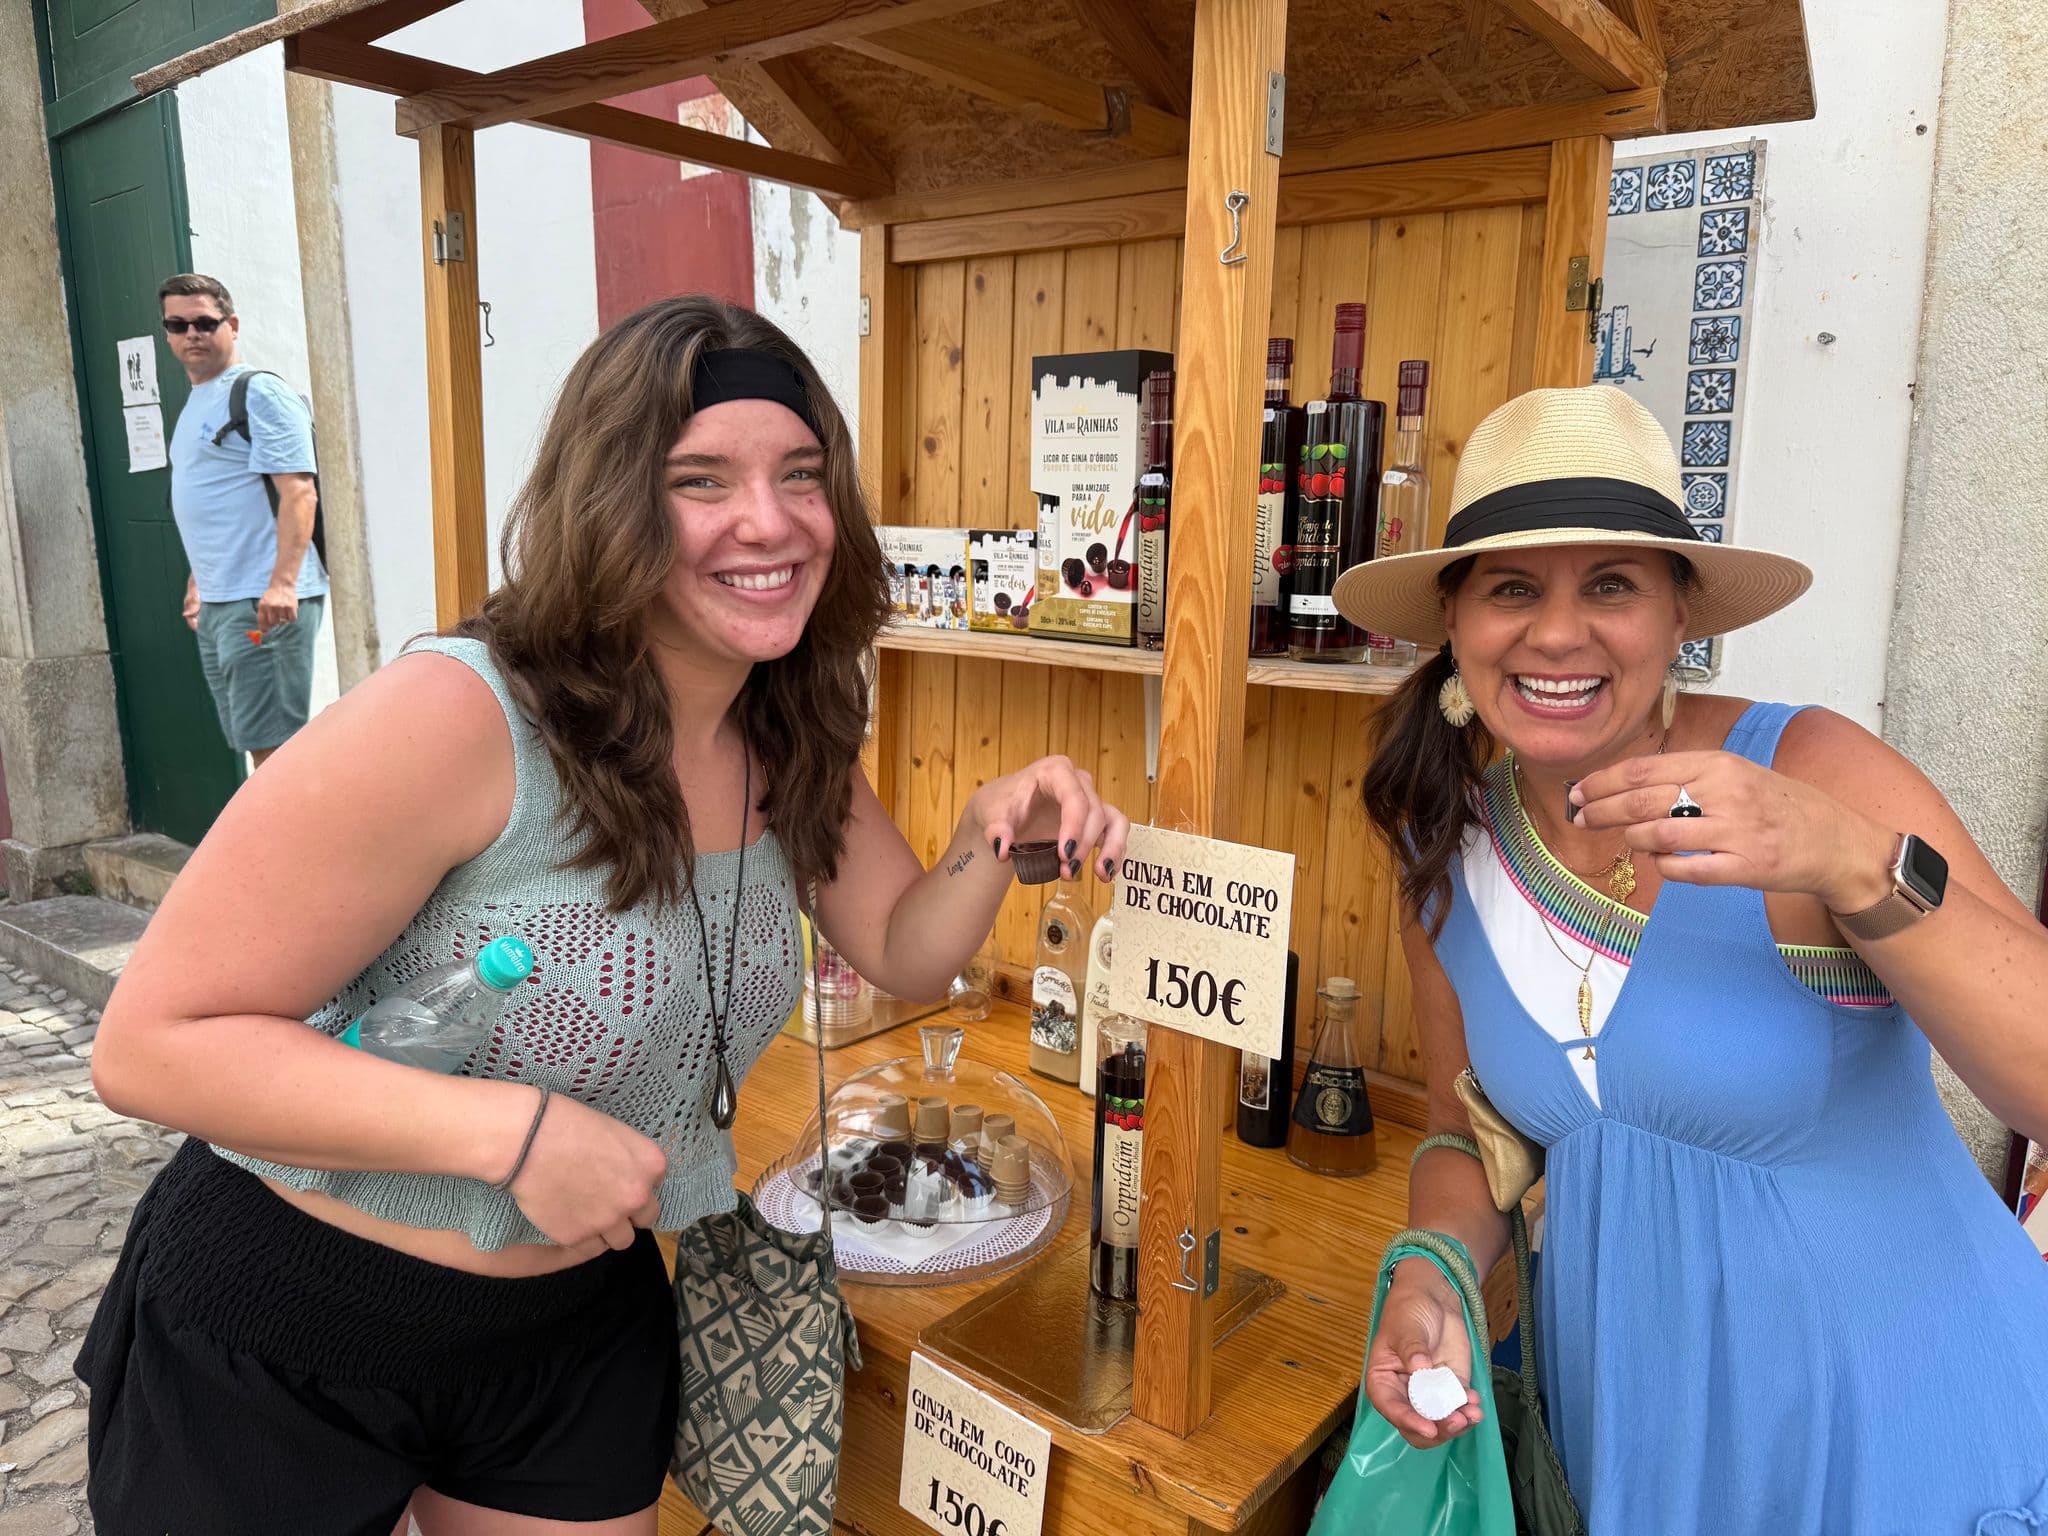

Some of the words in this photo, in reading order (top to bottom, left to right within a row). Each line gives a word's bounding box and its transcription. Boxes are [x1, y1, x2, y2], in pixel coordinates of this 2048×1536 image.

[130, 380, 144, 391] WC
[1045, 419, 1064, 434] VILA
[1077, 416, 1118, 436] RAINHAS
[1043, 454, 1059, 462] LICOR
[1062, 454, 1069, 462] DE
[1071, 454, 1087, 462] GINJA
[1072, 484, 1084, 492] UMA
[1085, 484, 1110, 492] AMIZADE
[1072, 493, 1086, 501] PARA
[1088, 493, 1092, 501] A
[1071, 494, 1118, 535] vida
[1252, 504, 1270, 585] Oppidum
[1140, 538, 1158, 617] Oppidum
[959, 851, 974, 865] Live
[1122, 858, 1174, 889] GINJA
[1182, 872, 1213, 898] EM
[1226, 881, 1279, 912] COPO
[1126, 886, 1150, 911] DE
[1157, 891, 1270, 939] CHOCOLATE
[500, 942, 526, 972] Vimeiro
[1144, 956, 1246, 1026] 1,50€
[1112, 1141, 1137, 1226] Oppidum
[912, 1388, 954, 1428] GINJA
[960, 1418, 984, 1446] EM
[994, 1440, 1036, 1478] COPO
[914, 1412, 934, 1438] DE
[939, 1428, 1028, 1498] CHOCOLATE
